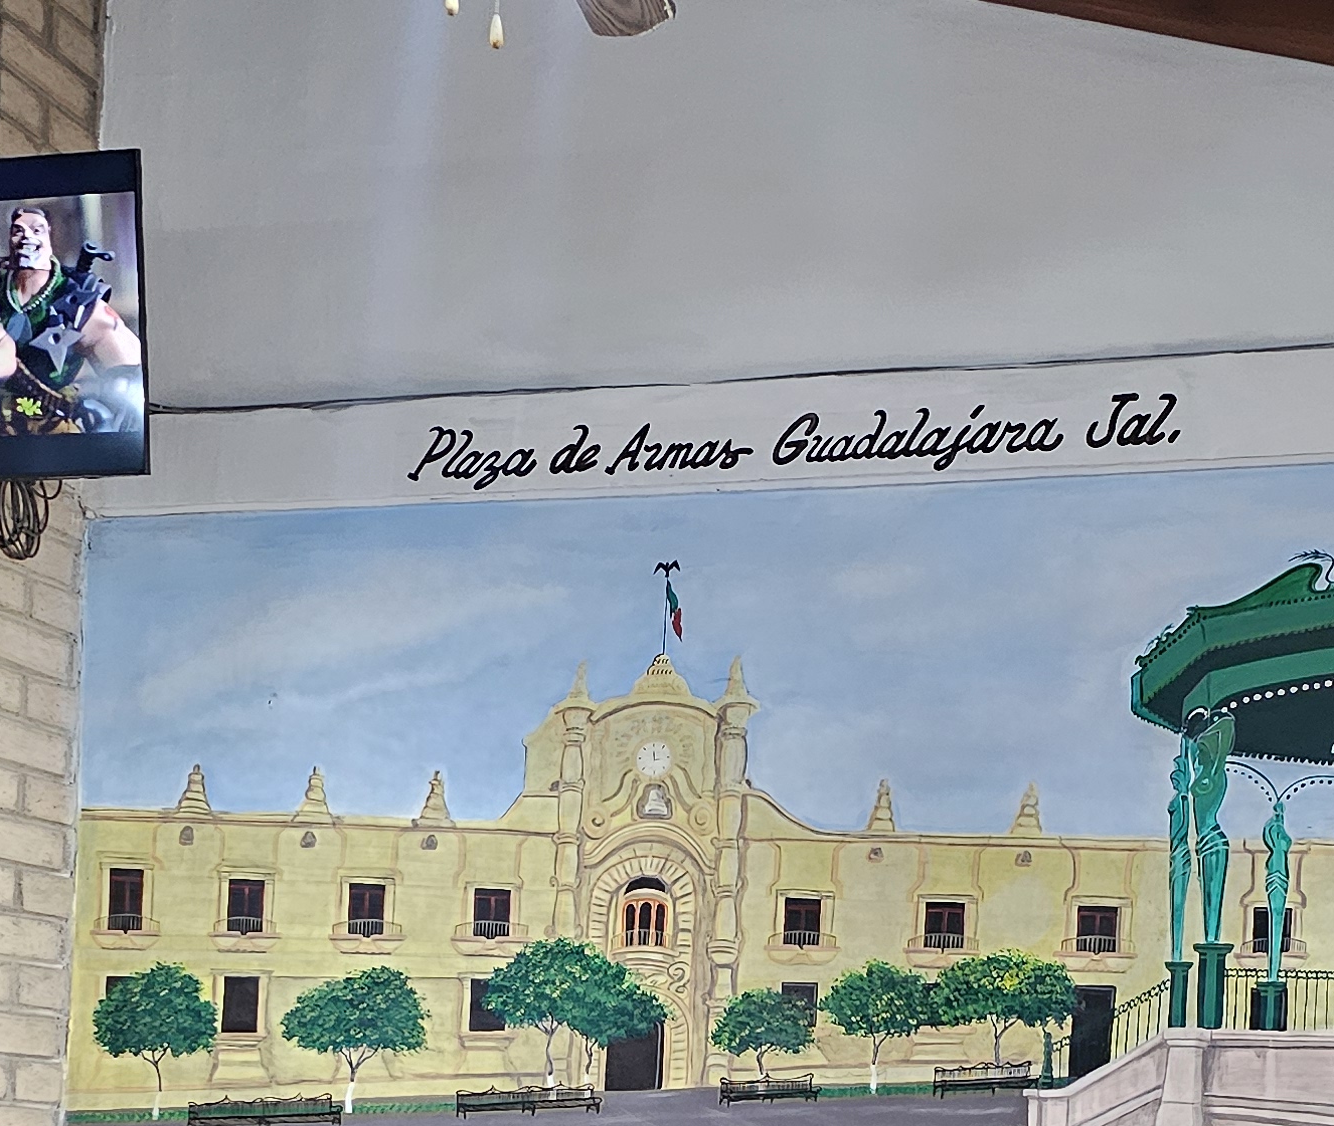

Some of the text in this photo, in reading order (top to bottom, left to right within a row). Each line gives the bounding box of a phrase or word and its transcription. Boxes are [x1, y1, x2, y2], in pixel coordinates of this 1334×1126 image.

[407, 392, 1181, 490] Plaza de Armas Guadalajara Jal.
